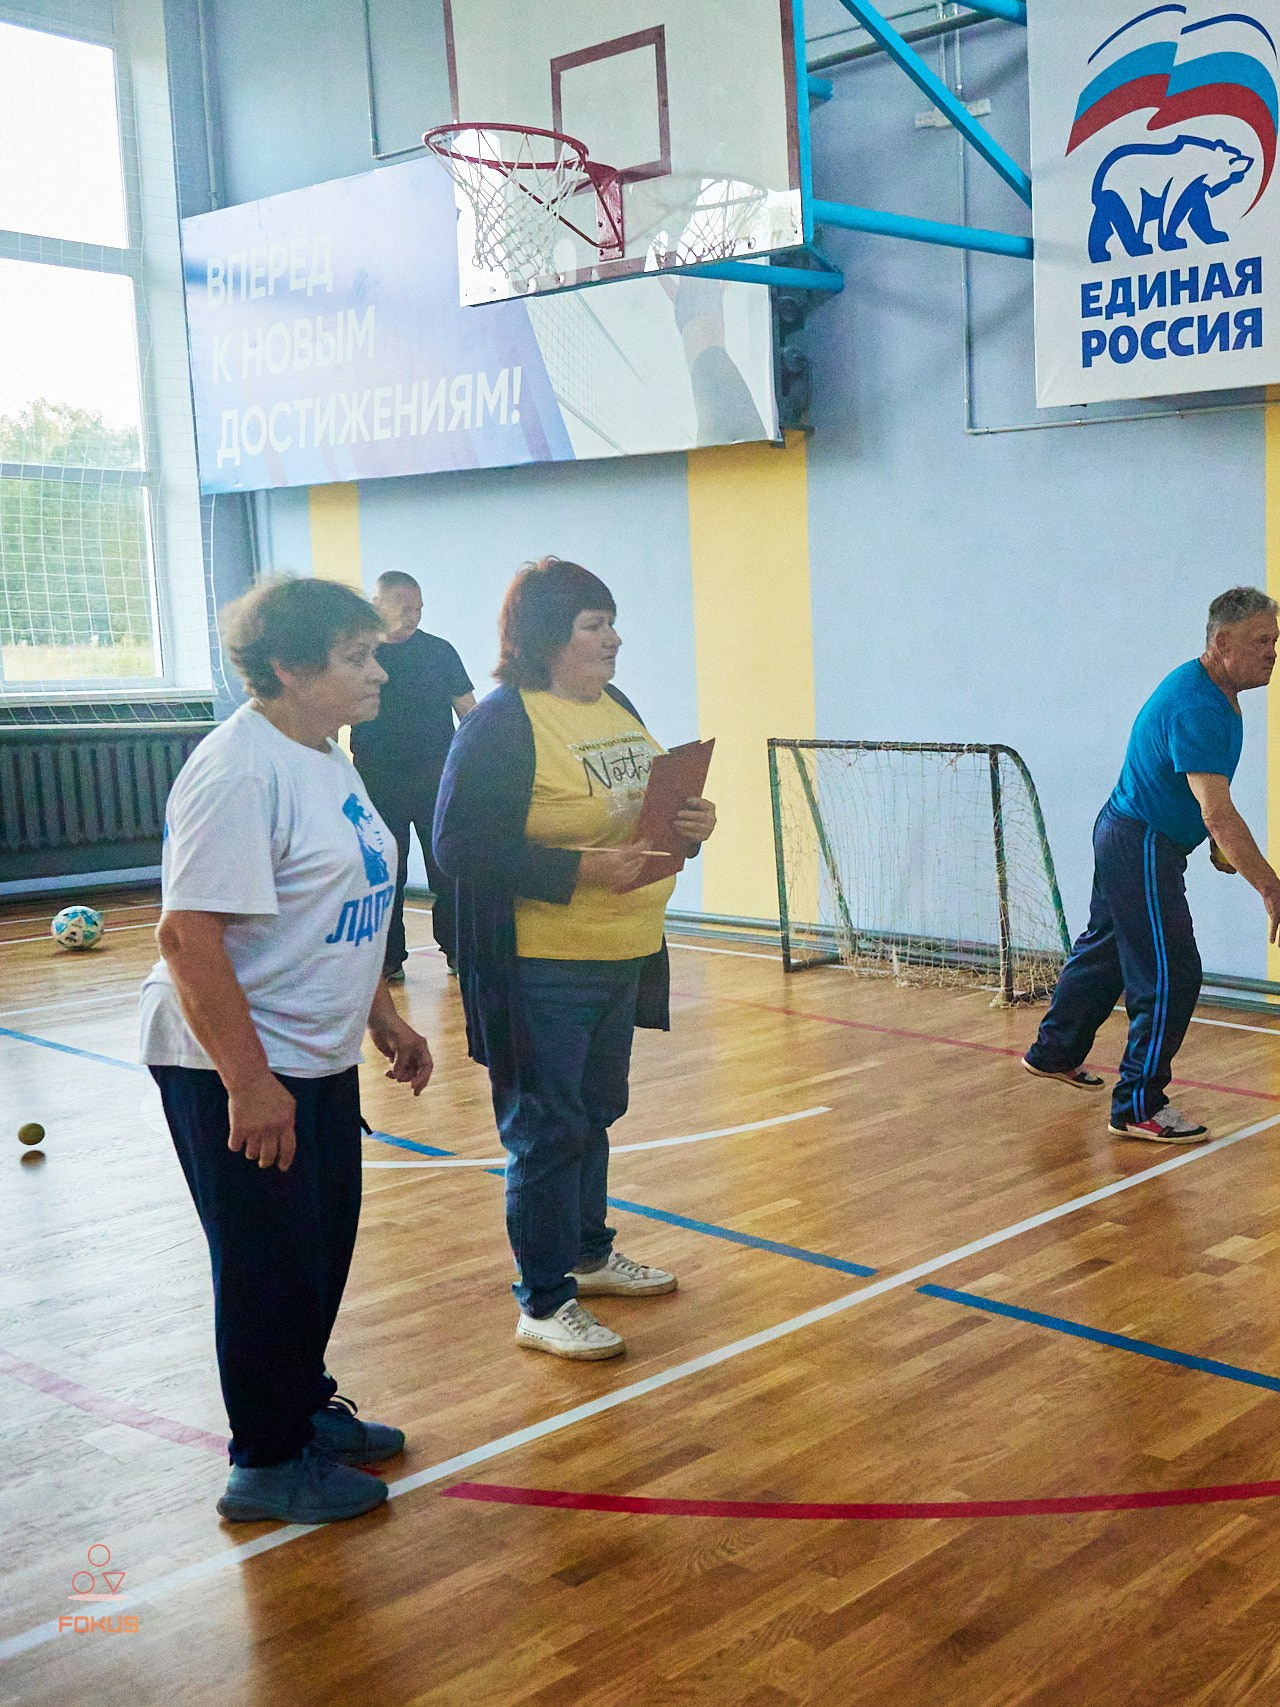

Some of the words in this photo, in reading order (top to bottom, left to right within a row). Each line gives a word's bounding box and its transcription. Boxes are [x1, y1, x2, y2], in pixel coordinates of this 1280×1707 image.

[1081, 256, 1262, 319] ЕДИНАЯ
[212, 334, 232, 383] К
[241, 304, 376, 380] НОВЫМ
[1081, 307, 1263, 368] РОССИЯ
[216, 366, 522, 467] ДОСТИЖЕНИЯМ!
